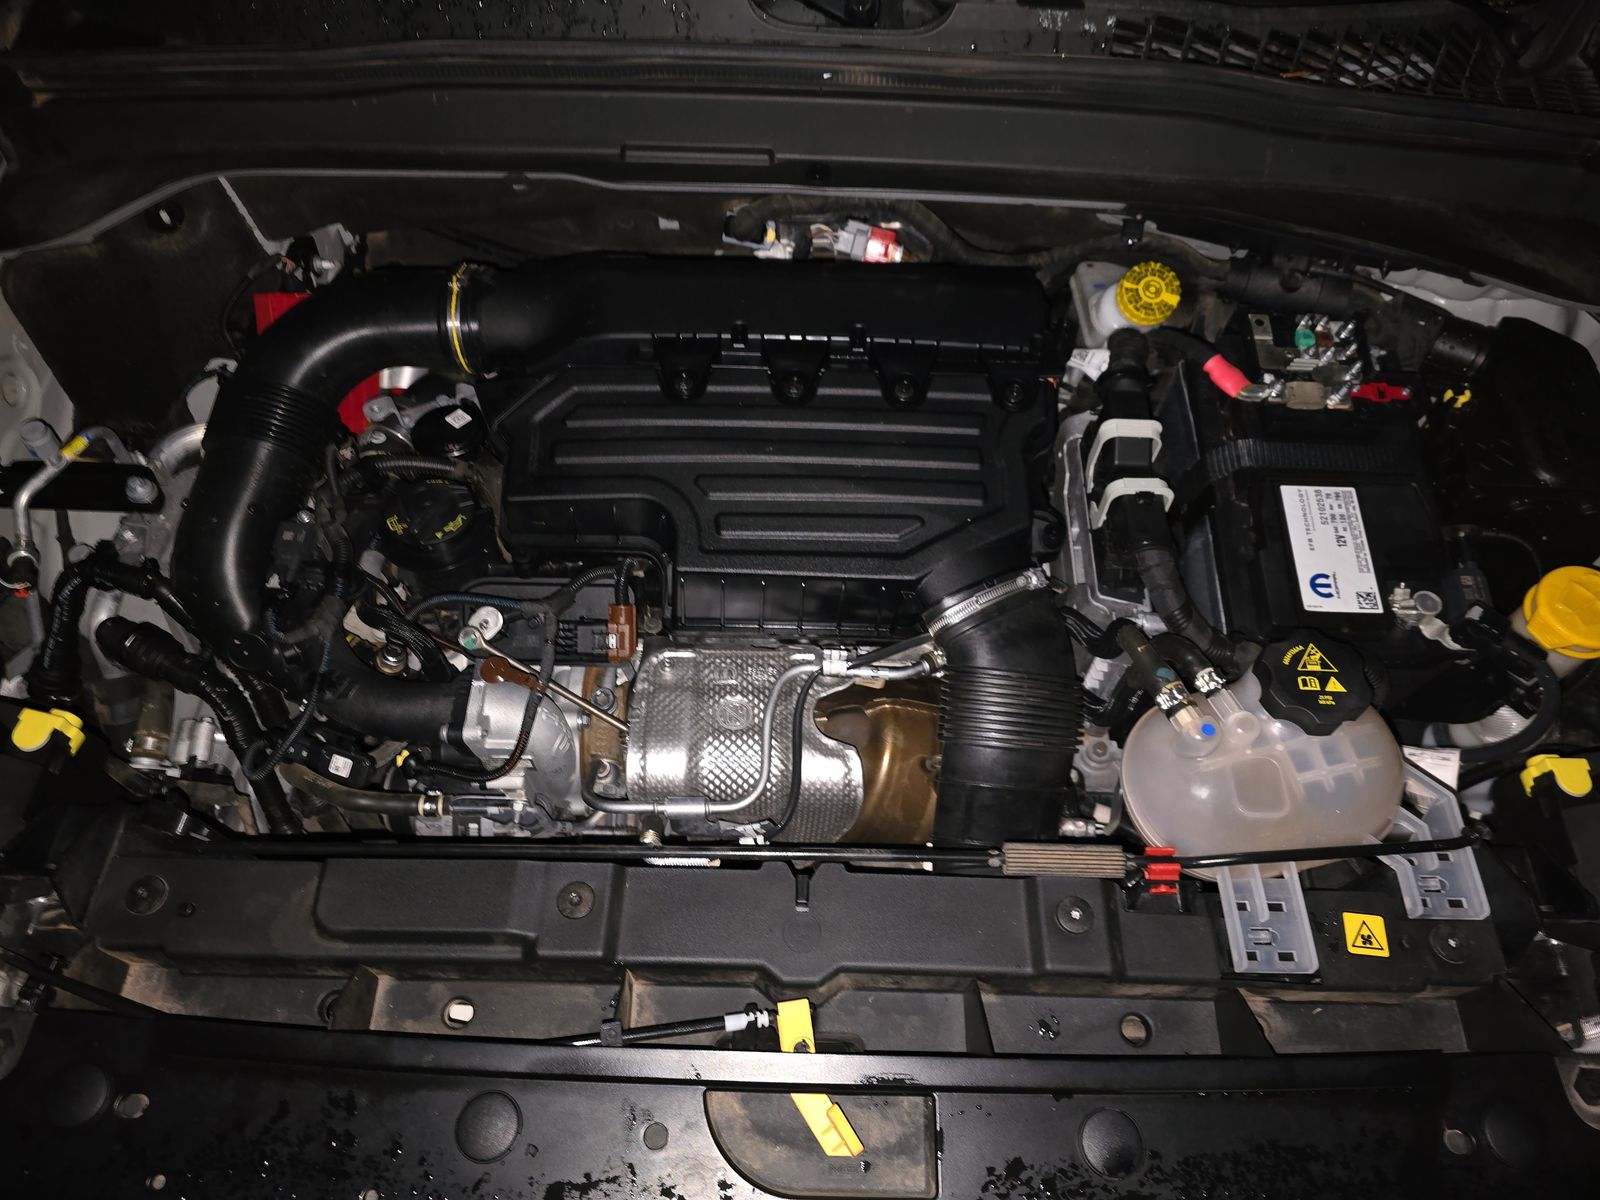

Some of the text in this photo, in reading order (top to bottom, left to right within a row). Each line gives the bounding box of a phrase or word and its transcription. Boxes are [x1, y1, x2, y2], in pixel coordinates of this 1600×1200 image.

[1297, 488, 1312, 535] TECHNOLOGY
[1314, 489, 1330, 525] 52102538
[1335, 534, 1348, 548] 12V
